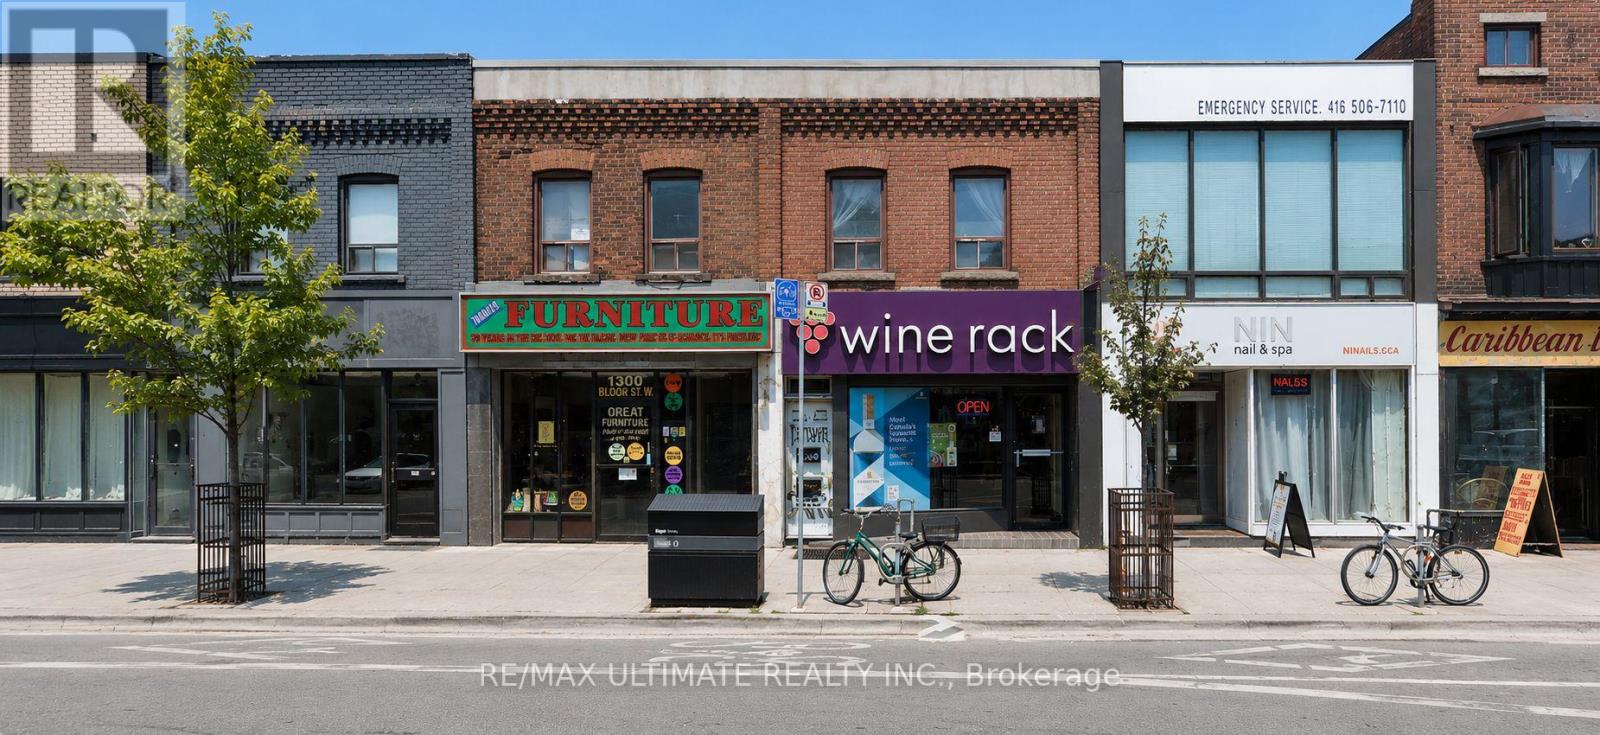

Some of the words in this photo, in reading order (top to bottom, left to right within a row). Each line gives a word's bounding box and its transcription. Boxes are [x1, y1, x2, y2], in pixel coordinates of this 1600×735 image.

[1198, 99, 1266, 116] EMERGENCY
[1271, 99, 1322, 115] SERVICE.
[1327, 99, 1346, 114] 416
[1351, 98, 1407, 114] 506-7110
[504, 299, 763, 329] FURNITURE
[840, 312, 954, 354] wine
[969, 308, 1075, 354] rack
[1234, 316, 1293, 343] NIN
[1446, 324, 1584, 353] Caribbean
[1234, 343, 1256, 355] nail
[1259, 344, 1269, 355] &
[1271, 346, 1293, 358] spa
[607, 375, 643, 387] 1300
[598, 386, 628, 397] BLOOR
[957, 400, 991, 414] OPEN
[601, 417, 649, 427] FURNITURE
